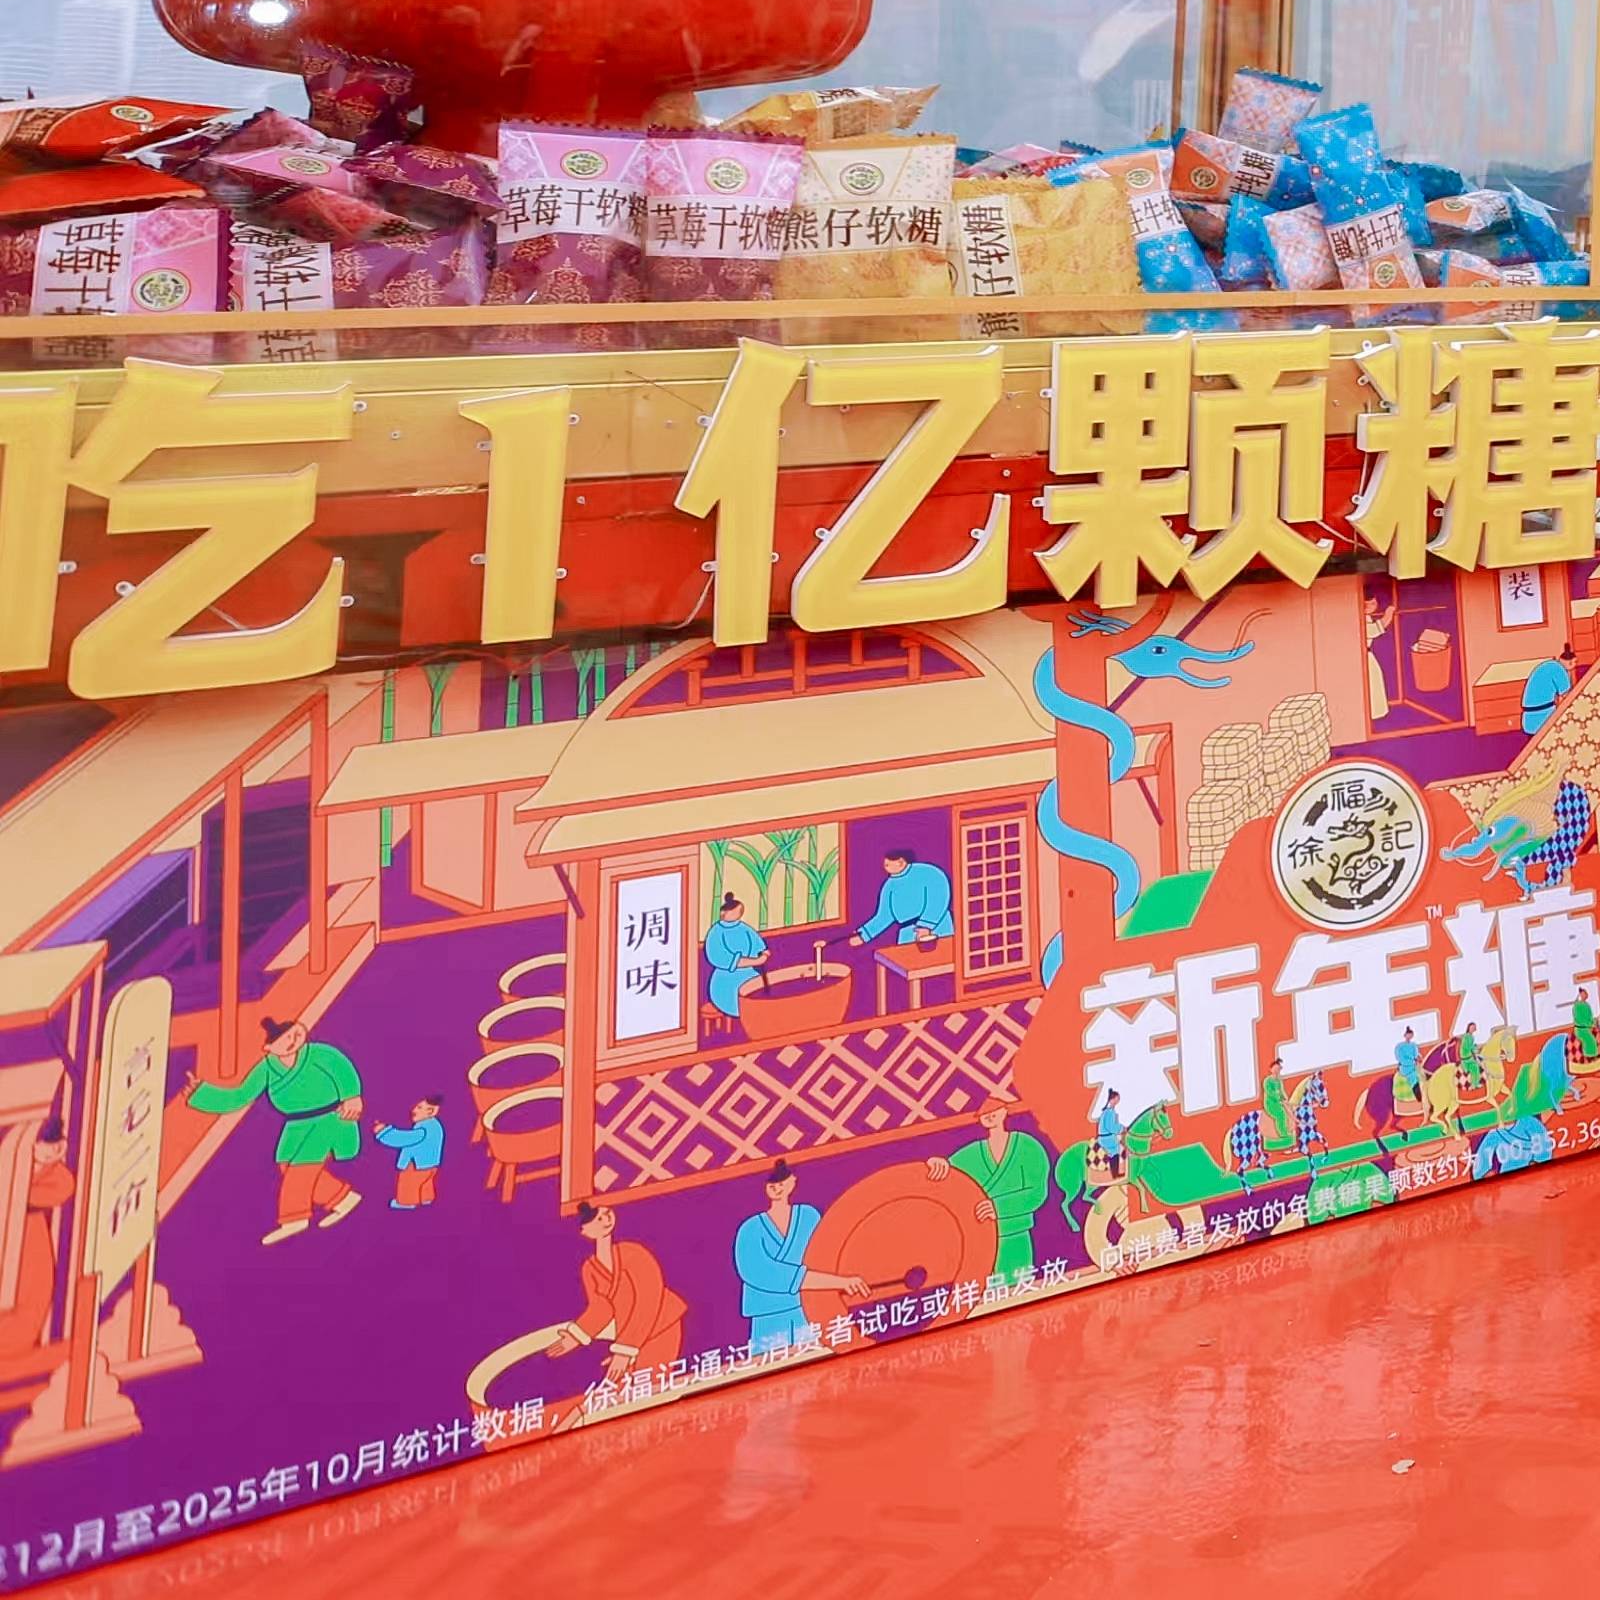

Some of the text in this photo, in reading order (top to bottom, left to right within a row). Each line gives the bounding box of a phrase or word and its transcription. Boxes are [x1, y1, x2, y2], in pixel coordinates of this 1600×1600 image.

[783, 204, 943, 252] 熊仔软糖
[624, 905, 679, 998] 调味
